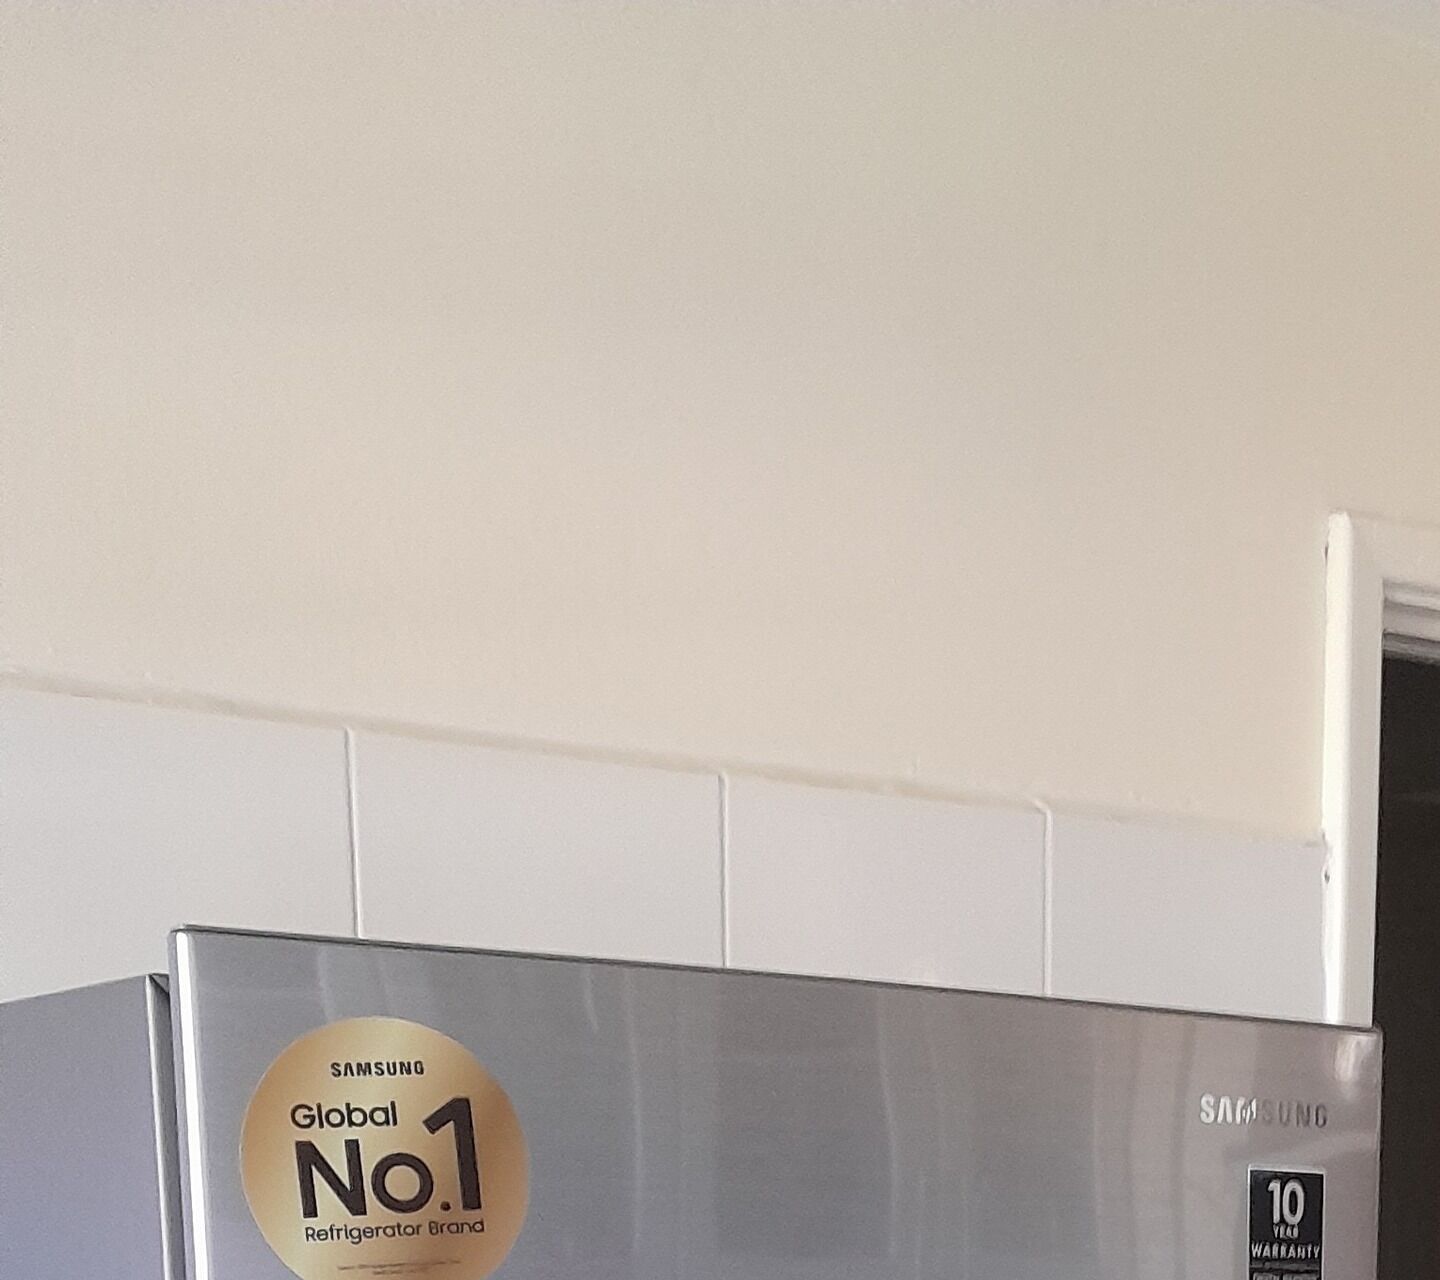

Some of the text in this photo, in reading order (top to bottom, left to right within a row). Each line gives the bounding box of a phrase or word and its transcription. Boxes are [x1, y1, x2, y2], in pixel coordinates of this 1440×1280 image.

[330, 1060, 424, 1078] SAMSUNG
[290, 1100, 398, 1129] Global
[1199, 1093, 1328, 1128] SAMSUNG
[294, 1096, 482, 1219] No.1
[1267, 1178, 1305, 1225] 10
[304, 1218, 485, 1244] Refrigerator Brand
[1251, 1243, 1320, 1259] WARRANTY
